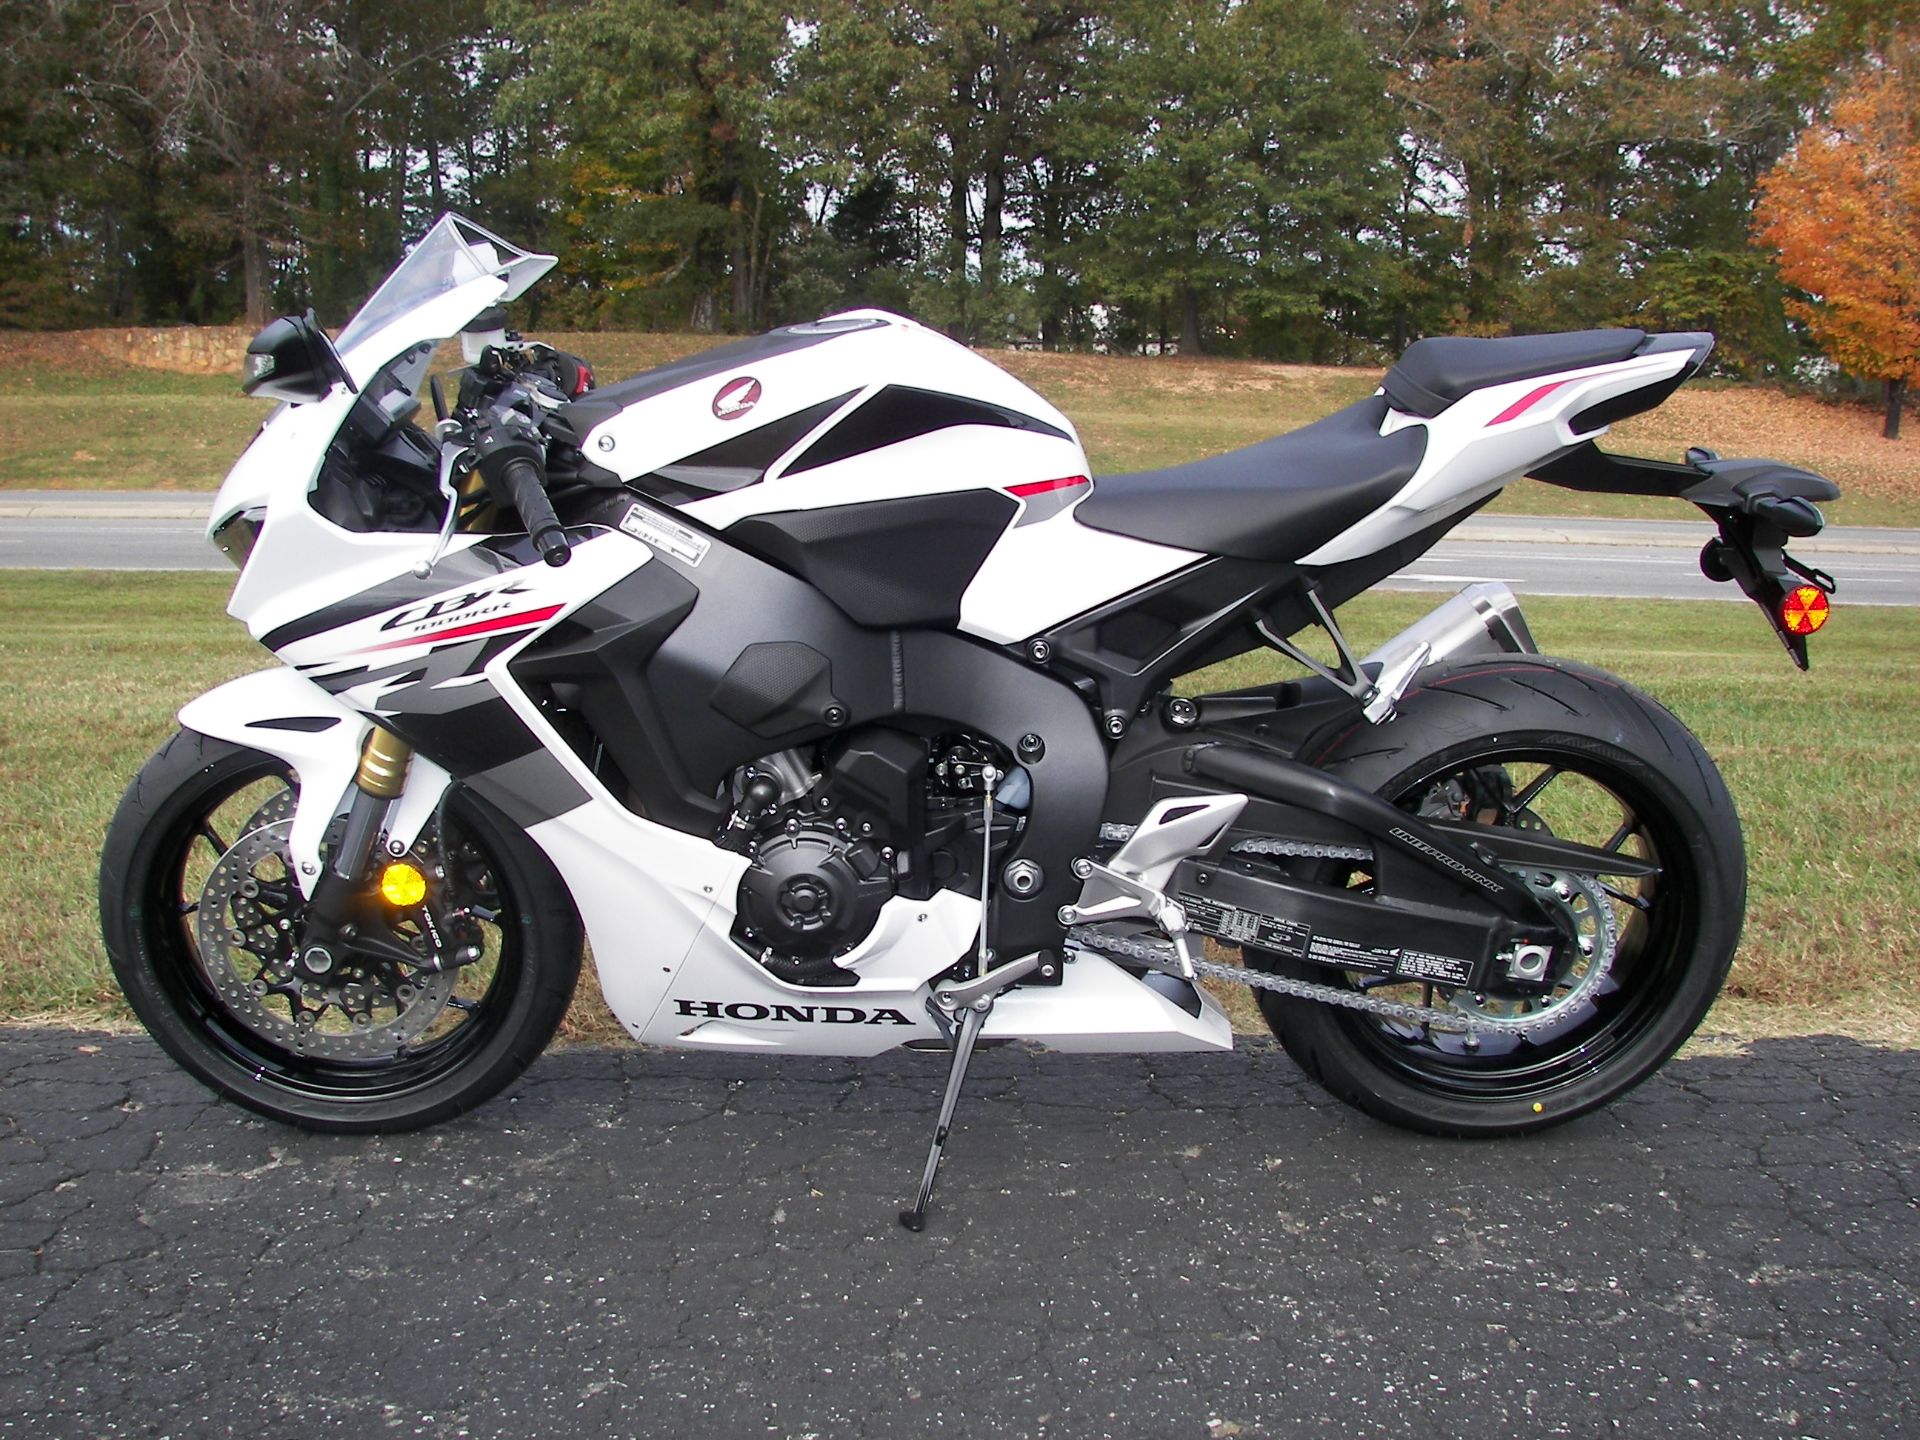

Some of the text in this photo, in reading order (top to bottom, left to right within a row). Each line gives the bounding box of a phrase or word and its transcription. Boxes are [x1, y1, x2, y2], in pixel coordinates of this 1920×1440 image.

[1389, 827, 1431, 852] UNIT
[422, 904, 442, 948] TOKICO
[673, 999, 917, 1025] HONDA
